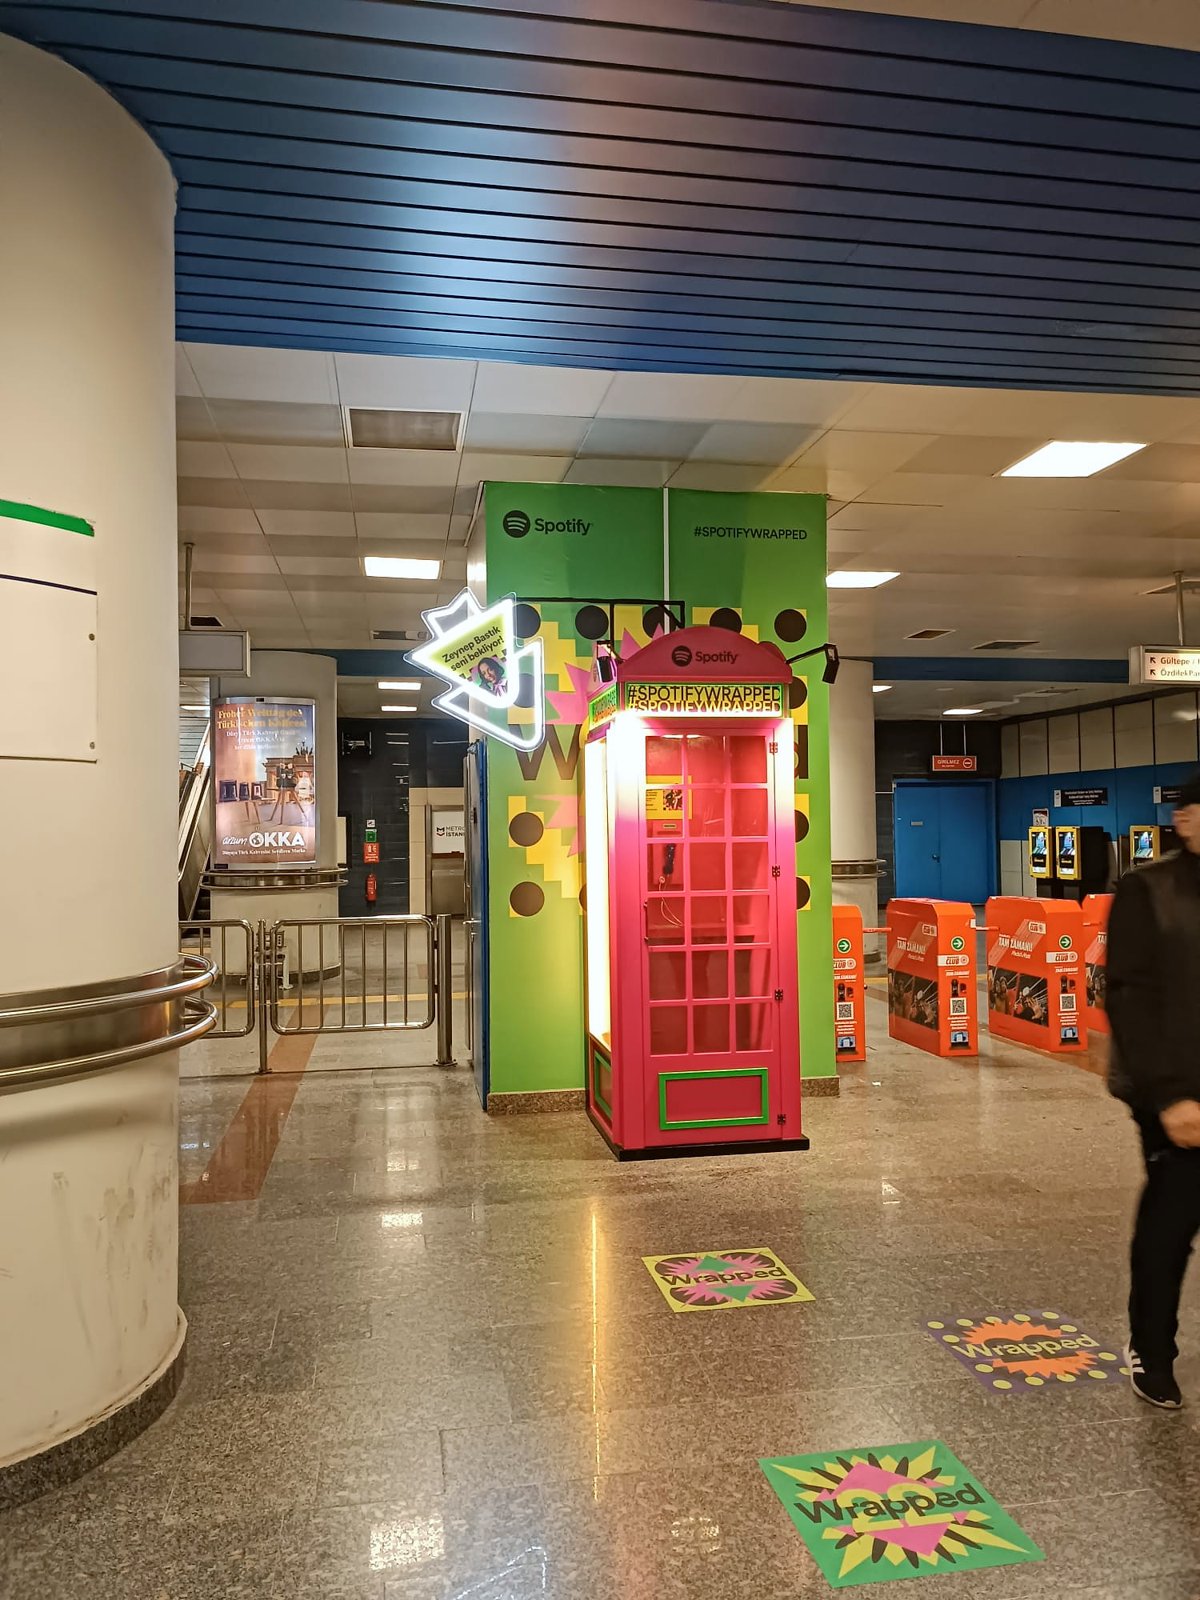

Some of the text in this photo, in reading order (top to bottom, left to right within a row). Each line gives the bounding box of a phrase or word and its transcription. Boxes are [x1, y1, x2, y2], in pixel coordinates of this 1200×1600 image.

[535, 518, 591, 536] Spotify
[694, 526, 808, 540] #SPOTIFYWRAPPED
[442, 626, 502, 663] Zeynep Bastık
[451, 635, 505, 671] seni bekliyor!
[695, 652, 738, 664] Spotify
[1160, 656, 1191, 666] Gültepe
[629, 685, 781, 701] #SPOTIFYWRAPPED
[249, 832, 305, 848] OKKA
[660, 1266, 788, 1286] Wrapped
[952, 1333, 1101, 1359] Wrapped
[794, 1482, 986, 1524] Wrapped
